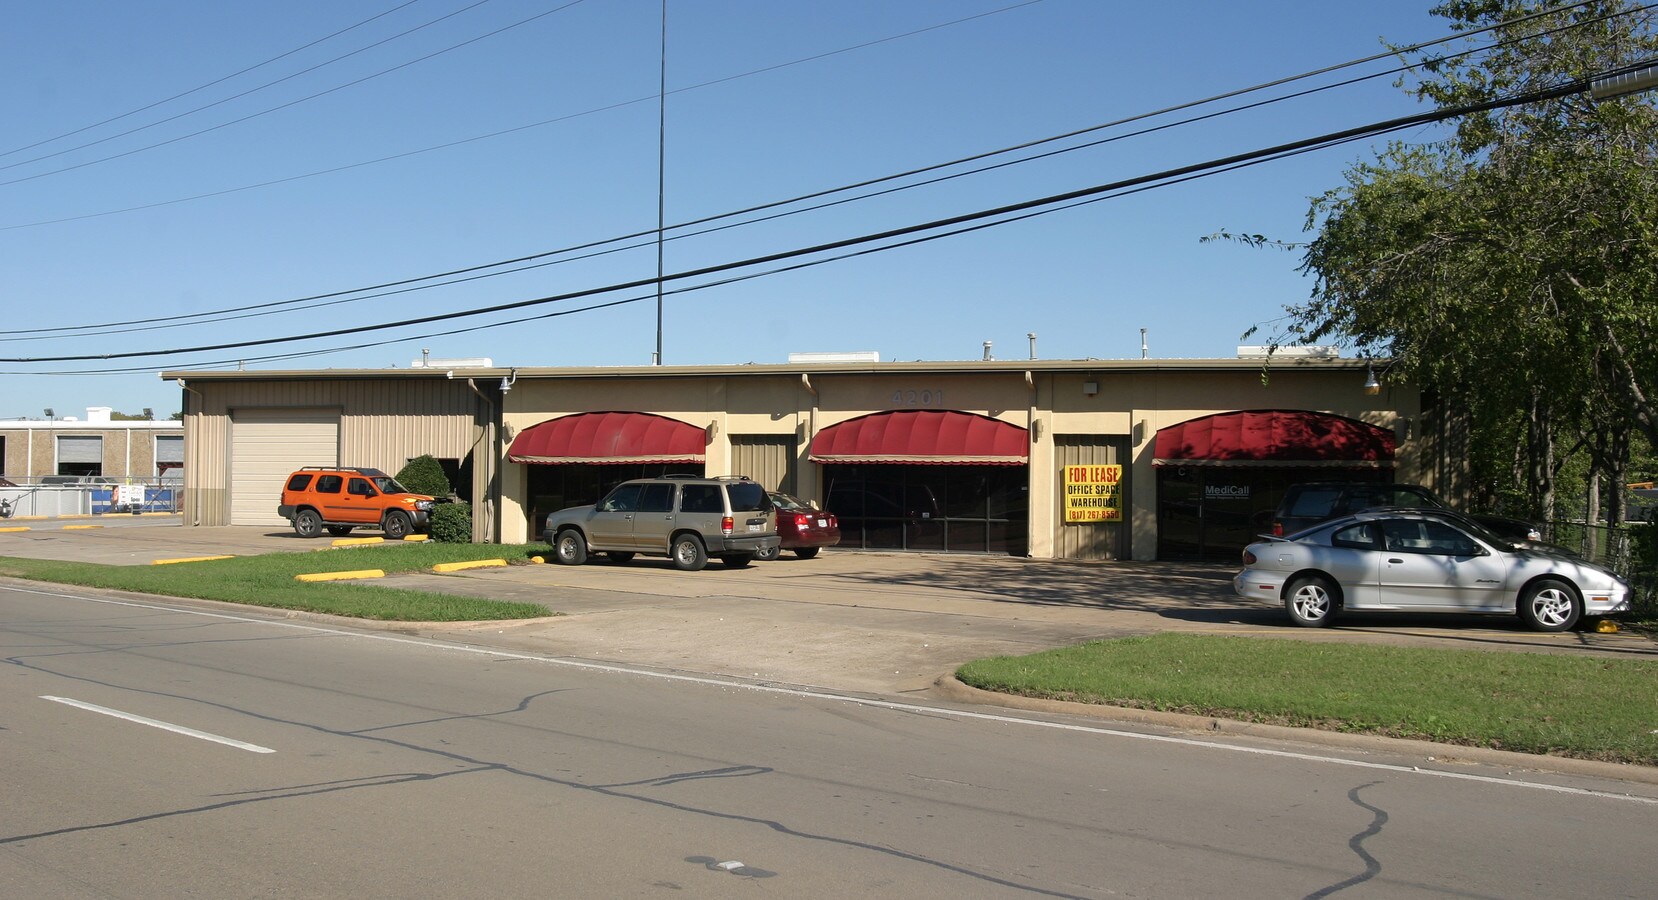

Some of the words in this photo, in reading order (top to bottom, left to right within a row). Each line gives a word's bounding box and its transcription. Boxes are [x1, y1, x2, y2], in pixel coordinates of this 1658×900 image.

[890, 389, 942, 406] 4201
[1069, 467, 1087, 483] FOR
[1090, 467, 1119, 483] LEASE
[1068, 485, 1093, 495] OFFICE
[1095, 485, 1120, 495] SPACE
[1205, 486, 1249, 494] MediCall
[1071, 498, 1117, 507] WAREHOUSE
[1069, 510, 1086, 520] (817)
